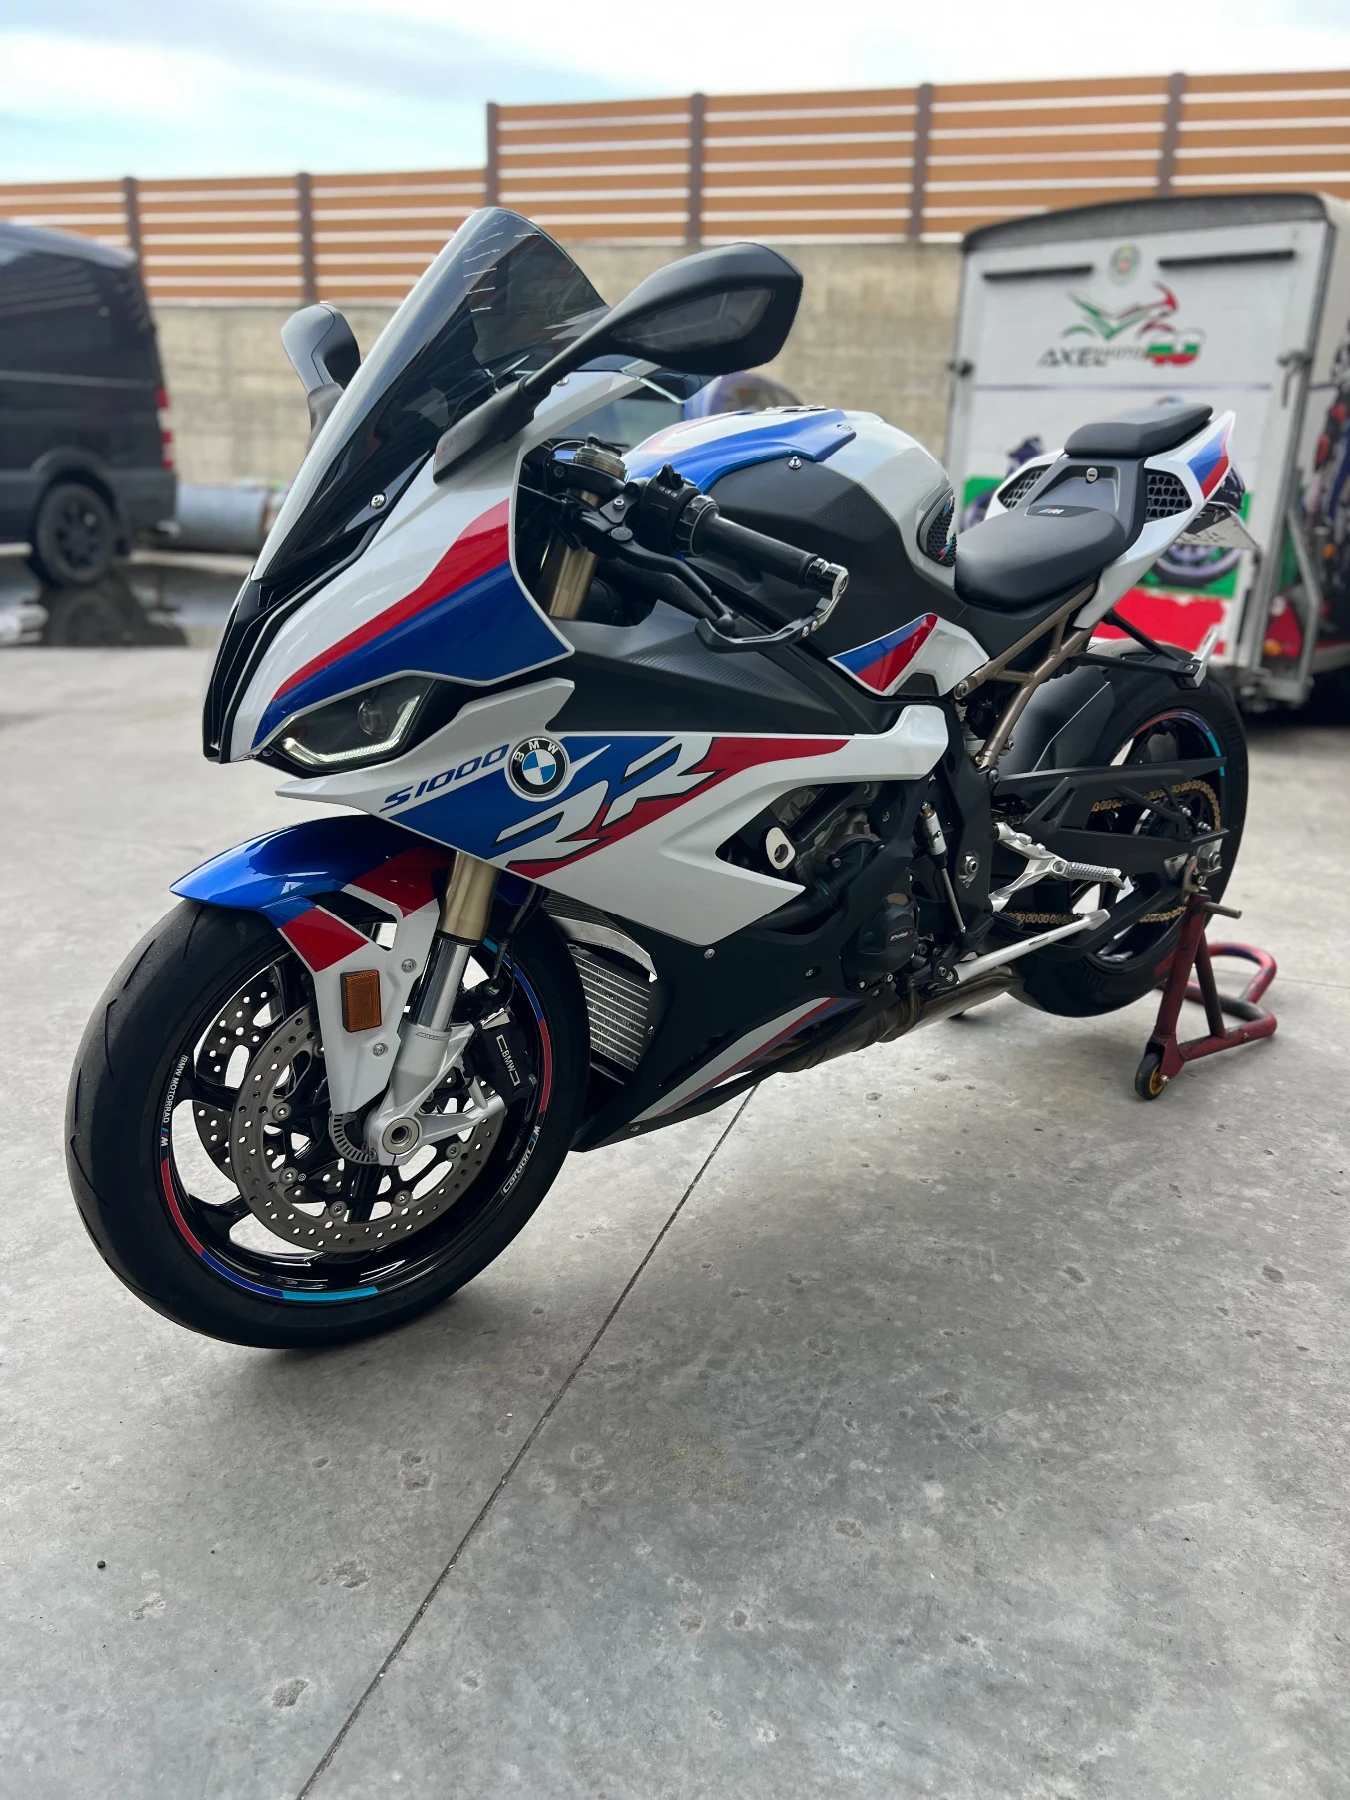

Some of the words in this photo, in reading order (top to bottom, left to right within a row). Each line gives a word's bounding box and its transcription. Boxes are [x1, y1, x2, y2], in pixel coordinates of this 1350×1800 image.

[512, 740, 560, 764] BMW
[378, 744, 510, 813] S1000
[174, 1054, 189, 1077] BMW
[501, 1049, 517, 1072] BMW
[162, 1077, 180, 1124] MOTORRAD
